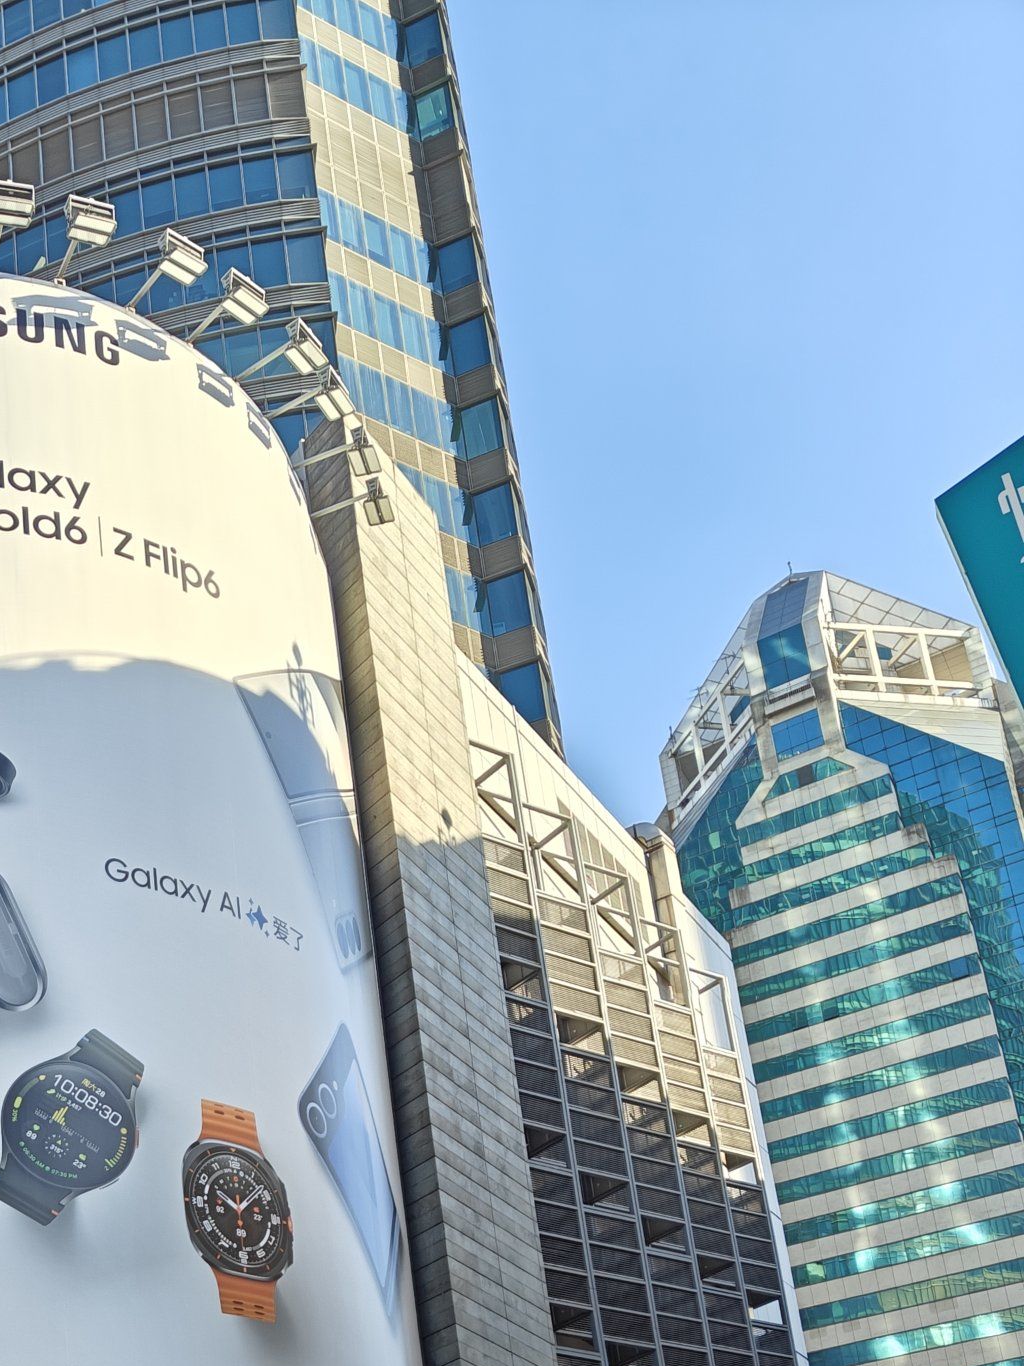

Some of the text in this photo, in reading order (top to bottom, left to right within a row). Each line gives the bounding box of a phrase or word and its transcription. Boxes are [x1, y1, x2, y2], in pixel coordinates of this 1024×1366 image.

[113, 527, 134, 561] Z
[143, 538, 220, 599] Flip6
[104, 858, 303, 951] Galaxy AI 爱了
[54, 1074, 123, 1126] 10:08:30
[26, 1130, 37, 1140] 89
